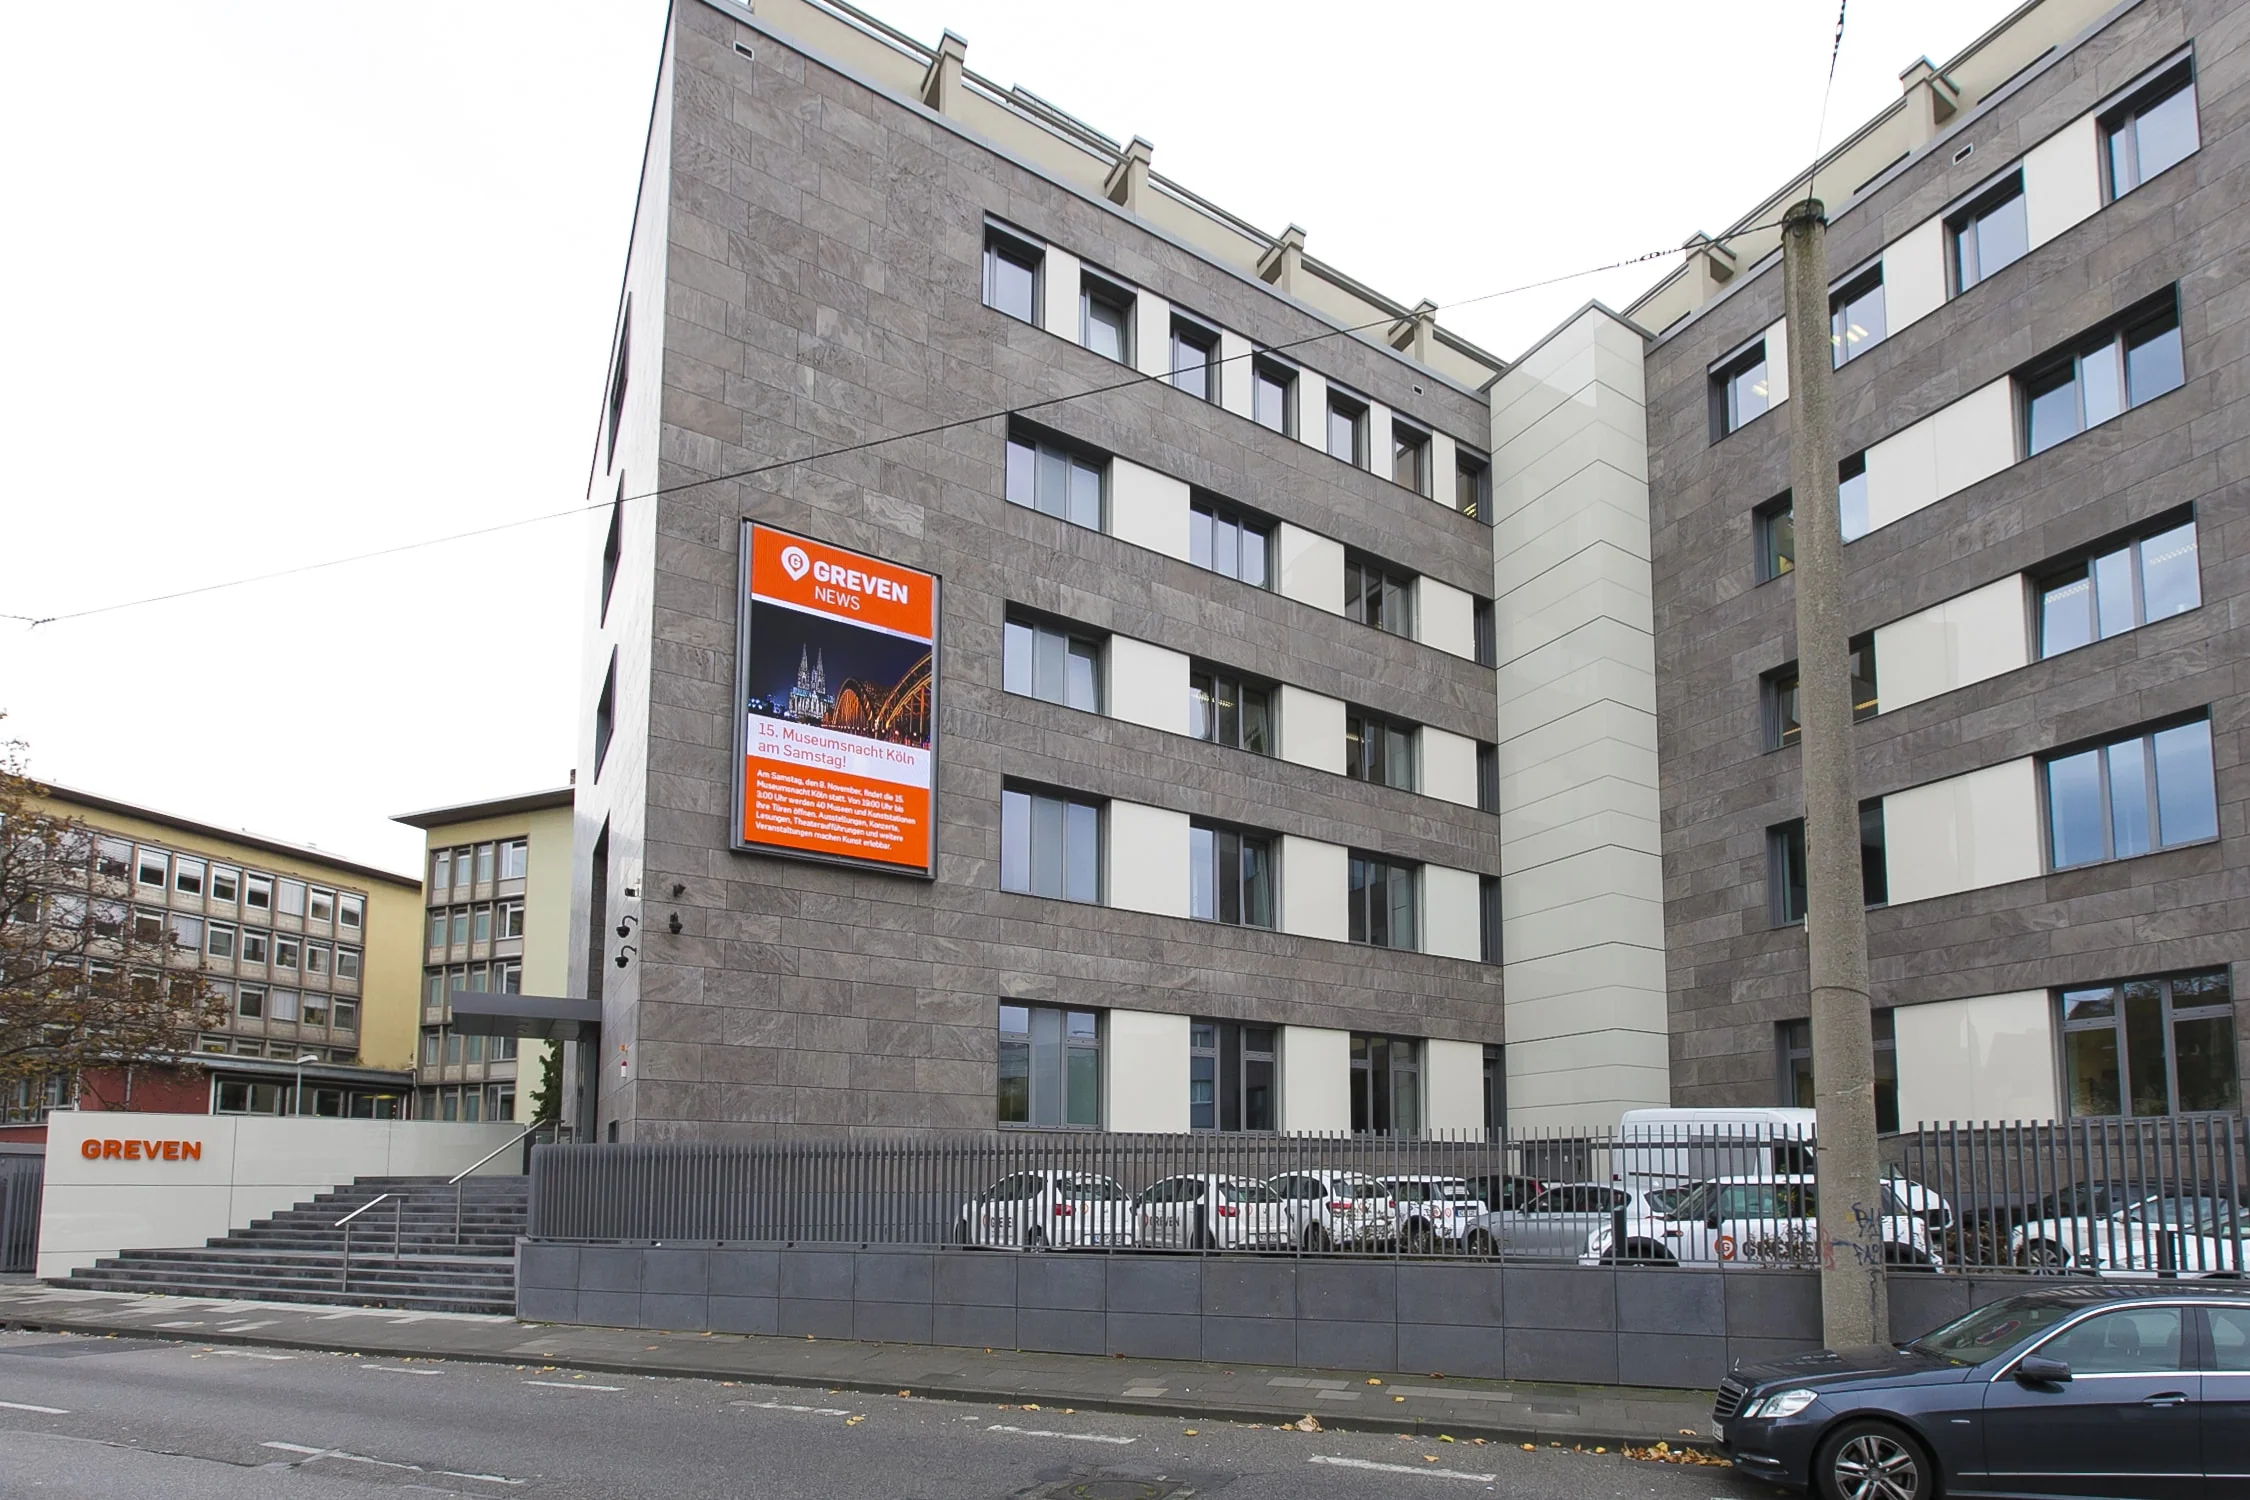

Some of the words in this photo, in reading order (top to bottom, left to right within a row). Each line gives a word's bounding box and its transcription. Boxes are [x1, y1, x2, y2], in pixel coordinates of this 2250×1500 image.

[813, 561, 908, 604] GREVEN
[815, 586, 861, 611] NEWS
[758, 722, 779, 738] 15.
[782, 727, 884, 758] Museumsnacht
[886, 746, 915, 766] Köln
[758, 742, 780, 756] am
[783, 745, 847, 769] Samstag!
[757, 769, 770, 779] Am
[805, 778, 819, 788] den
[883, 793, 894, 802] die
[757, 780, 811, 797] Museumsnacht
[811, 789, 828, 800] Köln
[847, 796, 861, 805] Von
[880, 802, 893, 811] Uhr
[894, 804, 904, 814] bis
[772, 802, 792, 814] Türen
[773, 793, 788, 803] Uhr
[788, 798, 815, 808] werden
[816, 800, 826, 810] 40
[826, 802, 853, 814] Museen
[853, 808, 867, 817] und
[755, 821, 813, 838] Veranstaltungen
[814, 831, 842, 844] machen
[842, 835, 862, 846] Kunst
[865, 829, 879, 838] und
[879, 832, 904, 843] weitere
[81, 1138, 202, 1161] GREVEN
